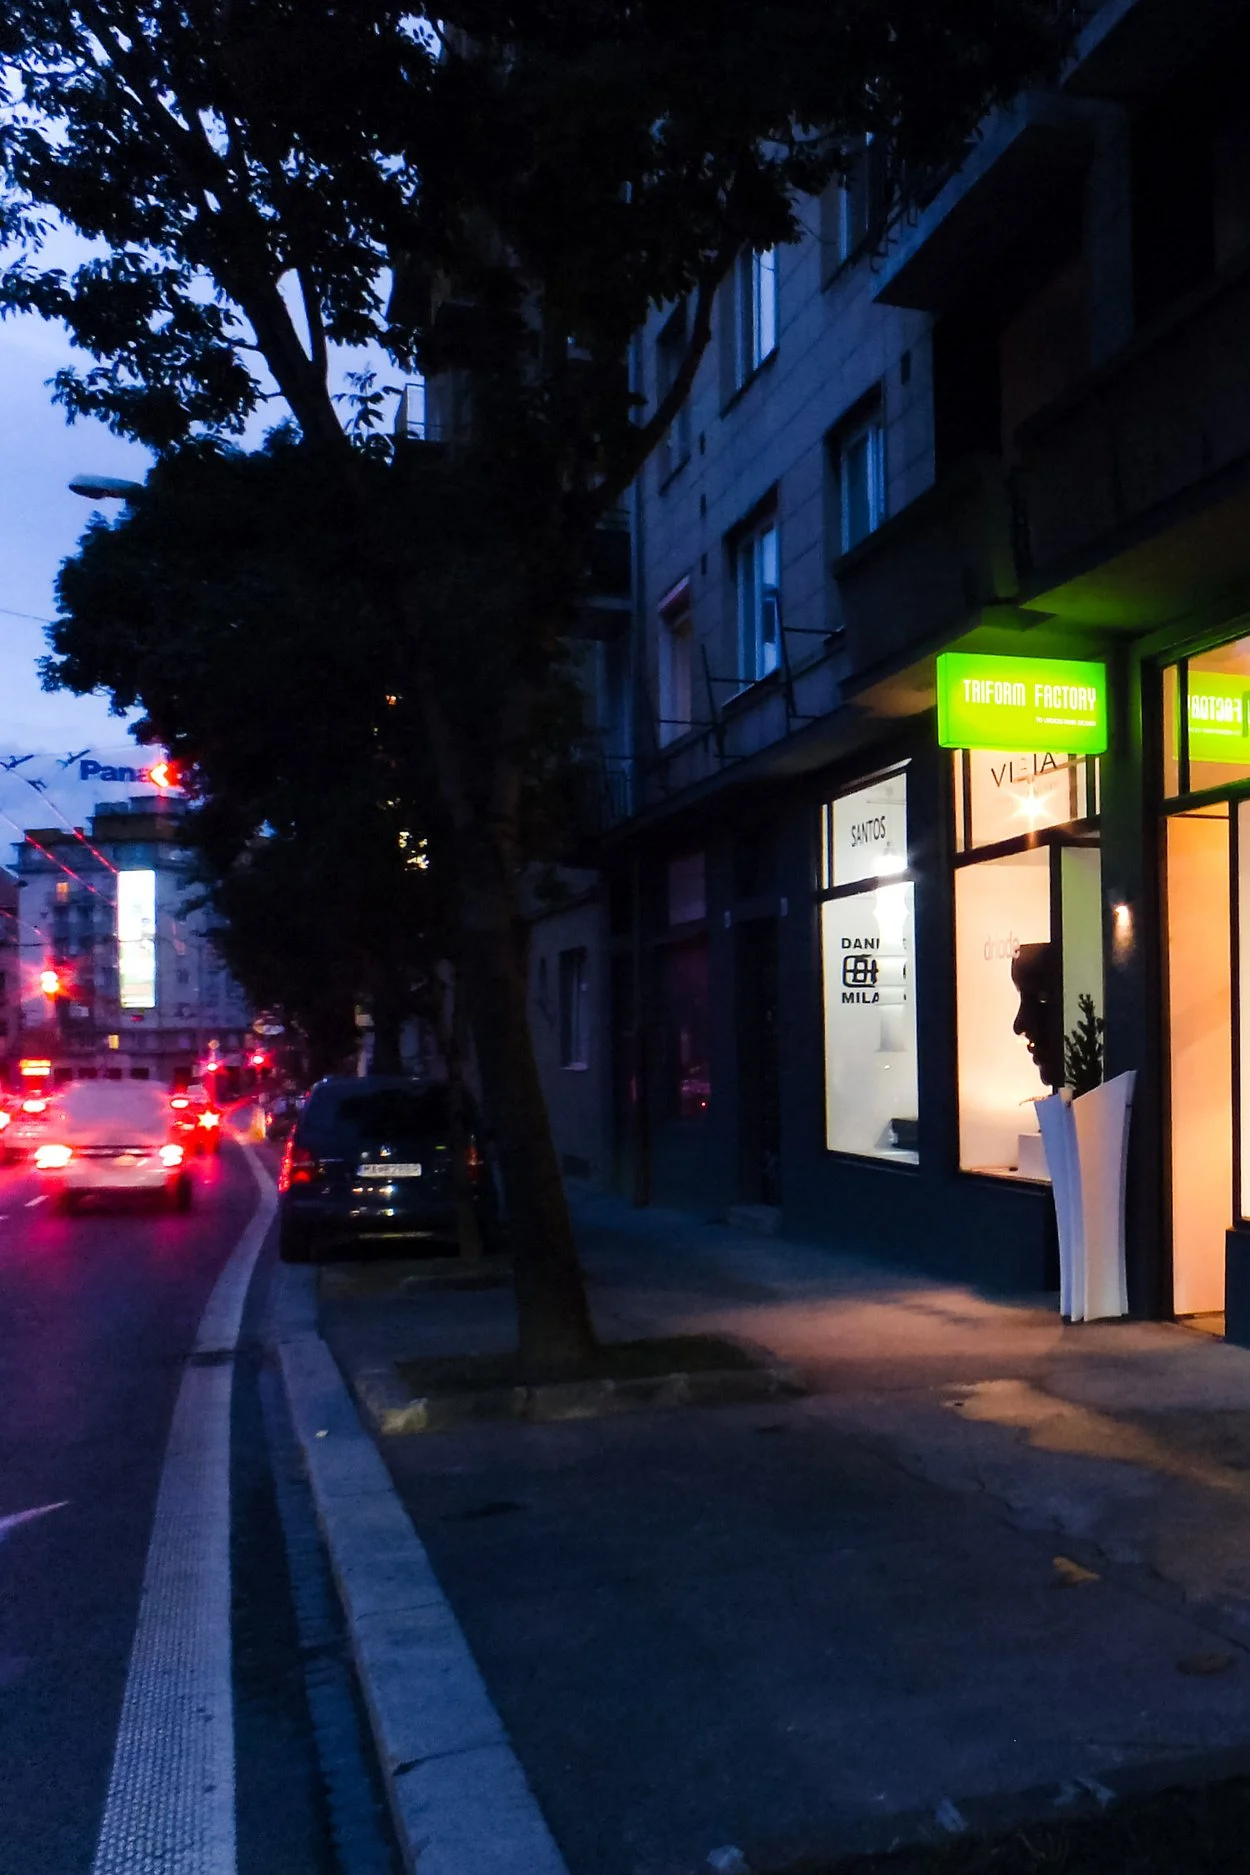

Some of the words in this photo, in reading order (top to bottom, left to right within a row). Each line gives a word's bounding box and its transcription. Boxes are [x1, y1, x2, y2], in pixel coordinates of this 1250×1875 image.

[963, 679, 1026, 707] TRIFORM
[1034, 684, 1097, 711] FACTORY
[991, 752, 1057, 788] VIIA
[850, 816, 886, 847] SANTOS
